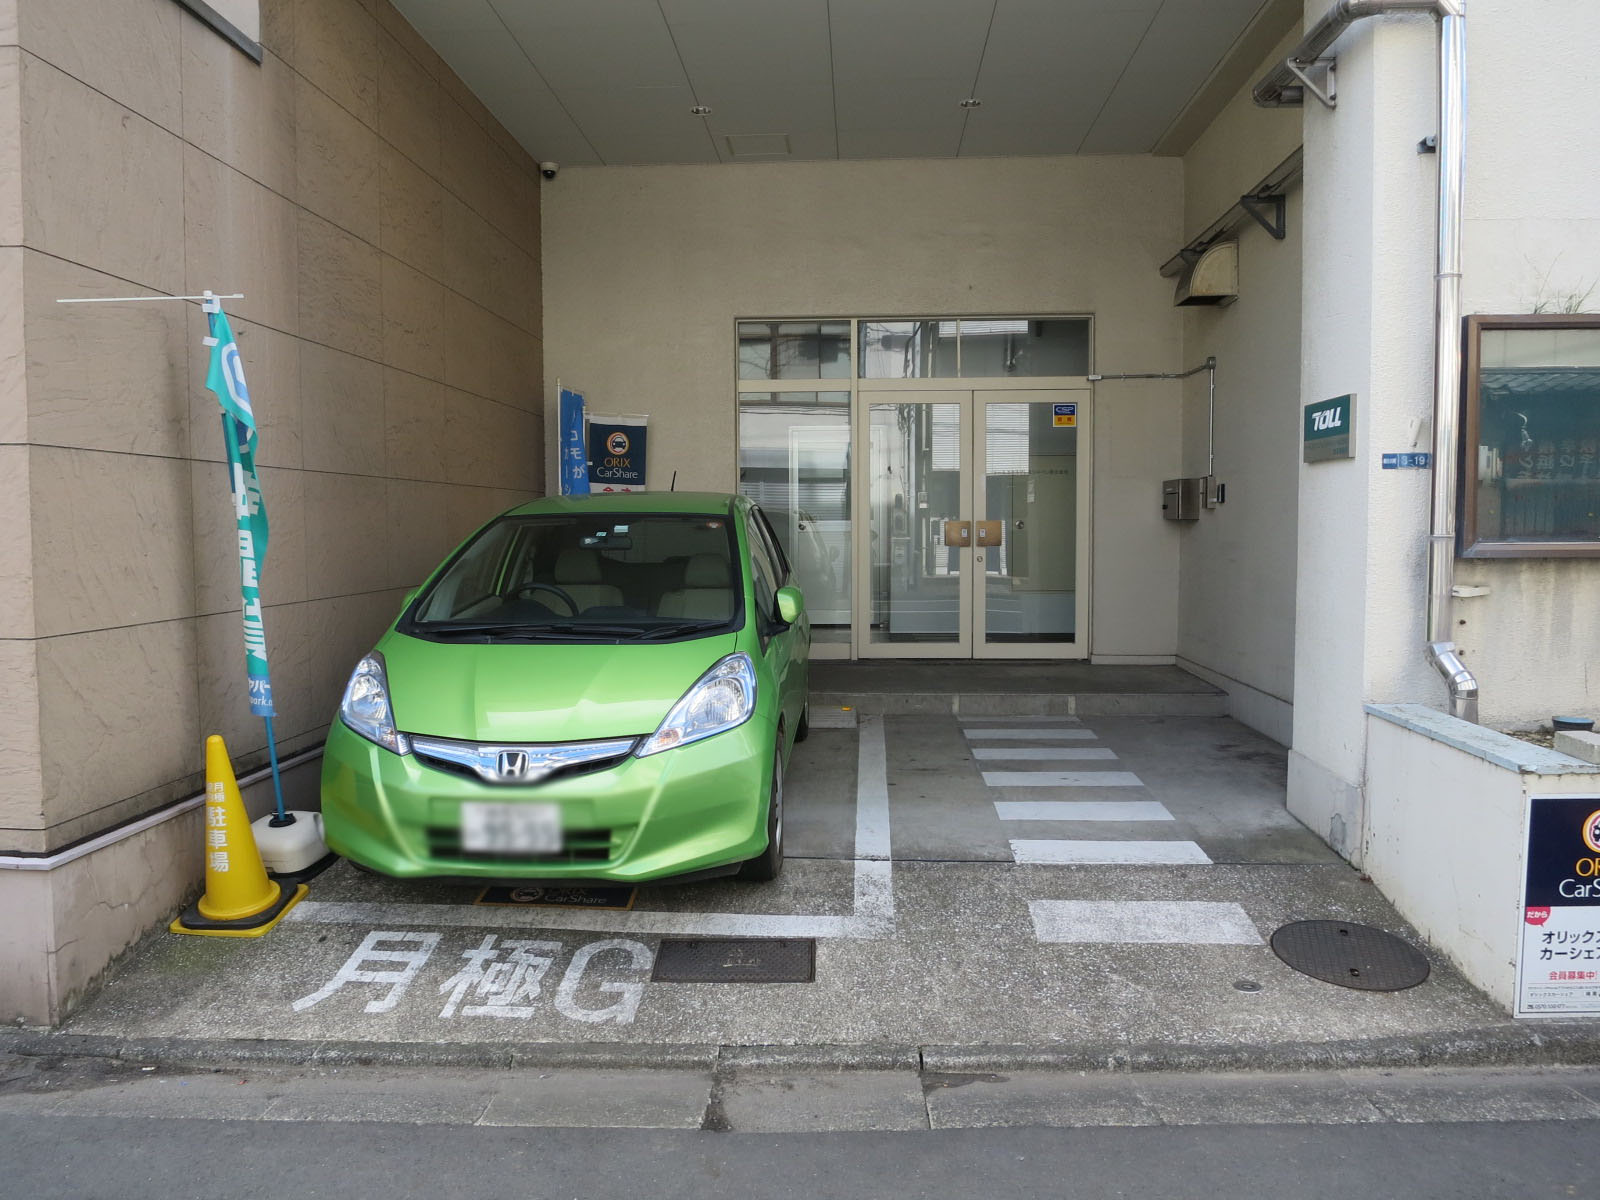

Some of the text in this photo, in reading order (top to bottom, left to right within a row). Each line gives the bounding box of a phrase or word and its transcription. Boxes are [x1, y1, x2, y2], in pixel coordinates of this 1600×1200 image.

[1311, 406, 1342, 432] TOLL
[604, 457, 631, 468] ORIX
[596, 467, 639, 479] CarShare
[207, 805, 229, 872] 駐車場
[544, 894, 608, 904] CarShare
[1526, 911, 1549, 919] だから
[291, 931, 654, 1025] 月極G
